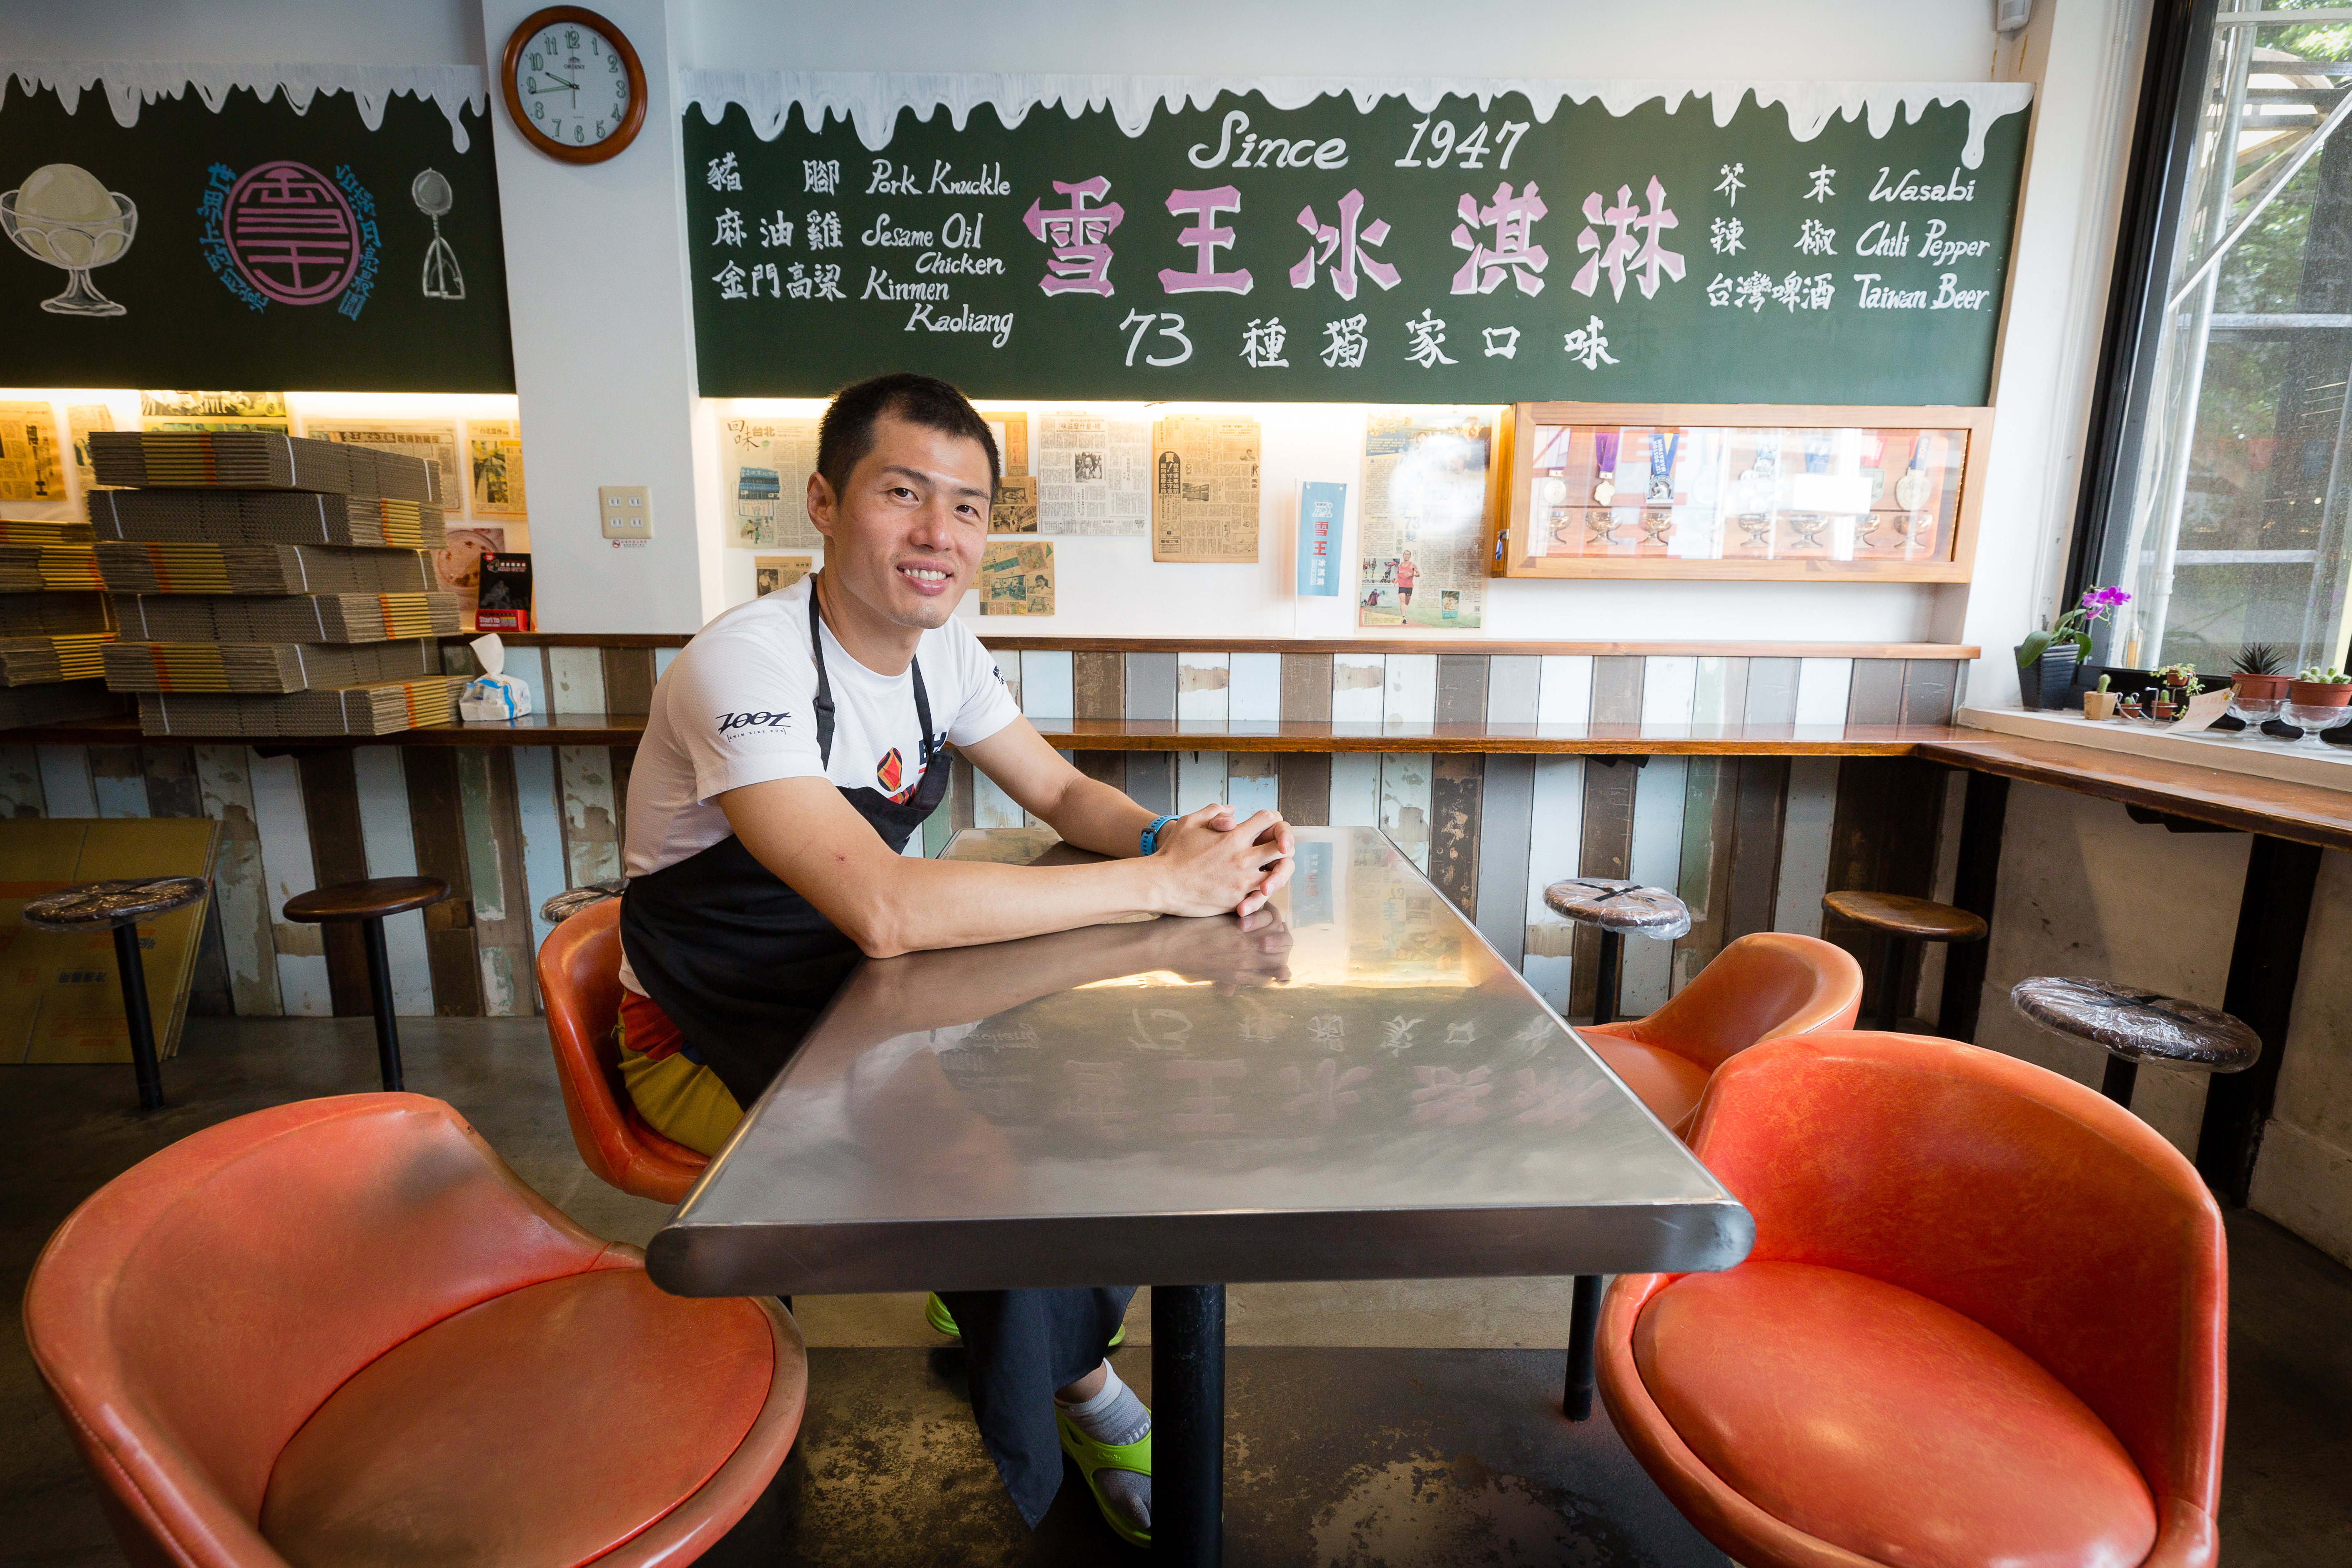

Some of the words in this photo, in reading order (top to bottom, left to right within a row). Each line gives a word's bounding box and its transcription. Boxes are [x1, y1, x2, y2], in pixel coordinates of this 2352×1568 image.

[545, 36, 558, 55] 11
[565, 30, 580, 49] 12
[591, 37, 599, 55] 1
[529, 52, 544, 71] 10
[607, 54, 618, 73] 2
[527, 76, 537, 94] 9
[616, 80, 626, 98] 3
[534, 101, 545, 119] 8
[611, 103, 621, 121] 4
[552, 118, 561, 137] 7
[574, 125, 584, 143] 6
[596, 120, 605, 138] 5
[1188, 110, 1349, 170] Since
[1395, 118, 1529, 170] 1947
[865, 159, 923, 195] Pork
[927, 159, 1011, 196] Knuckle
[1713, 163, 1837, 207] 芥末
[1868, 166, 1976, 202] Wasabi
[711, 207, 844, 251] 麻油雞
[861, 213, 934, 248] Sesame
[942, 212, 984, 249] Oil
[1022, 175, 1686, 303] 雪王冰淇淋
[1709, 217, 1839, 256] 辣椒
[1855, 220, 1910, 257] Chili
[1917, 218, 1991, 266] Pepper
[915, 252, 1006, 275] Chicken
[860, 266, 950, 301] Kinmen
[1706, 270, 1836, 313] 台灣啤酒
[1854, 273, 1927, 310] Taiwan
[1930, 272, 1991, 311] Beer
[904, 303, 1014, 348] Kaoliang
[1119, 307, 1193, 367] 73
[1241, 308, 1620, 370] 種獨家口味
[727, 420, 759, 451] 回味
[752, 426, 775, 437] 台北
[1918, 438, 1929, 459] 2019
[1657, 439, 1667, 472] MARATHON
[1313, 521, 1329, 555] 雪王
[1317, 559, 1326, 586] 冰淇淋
